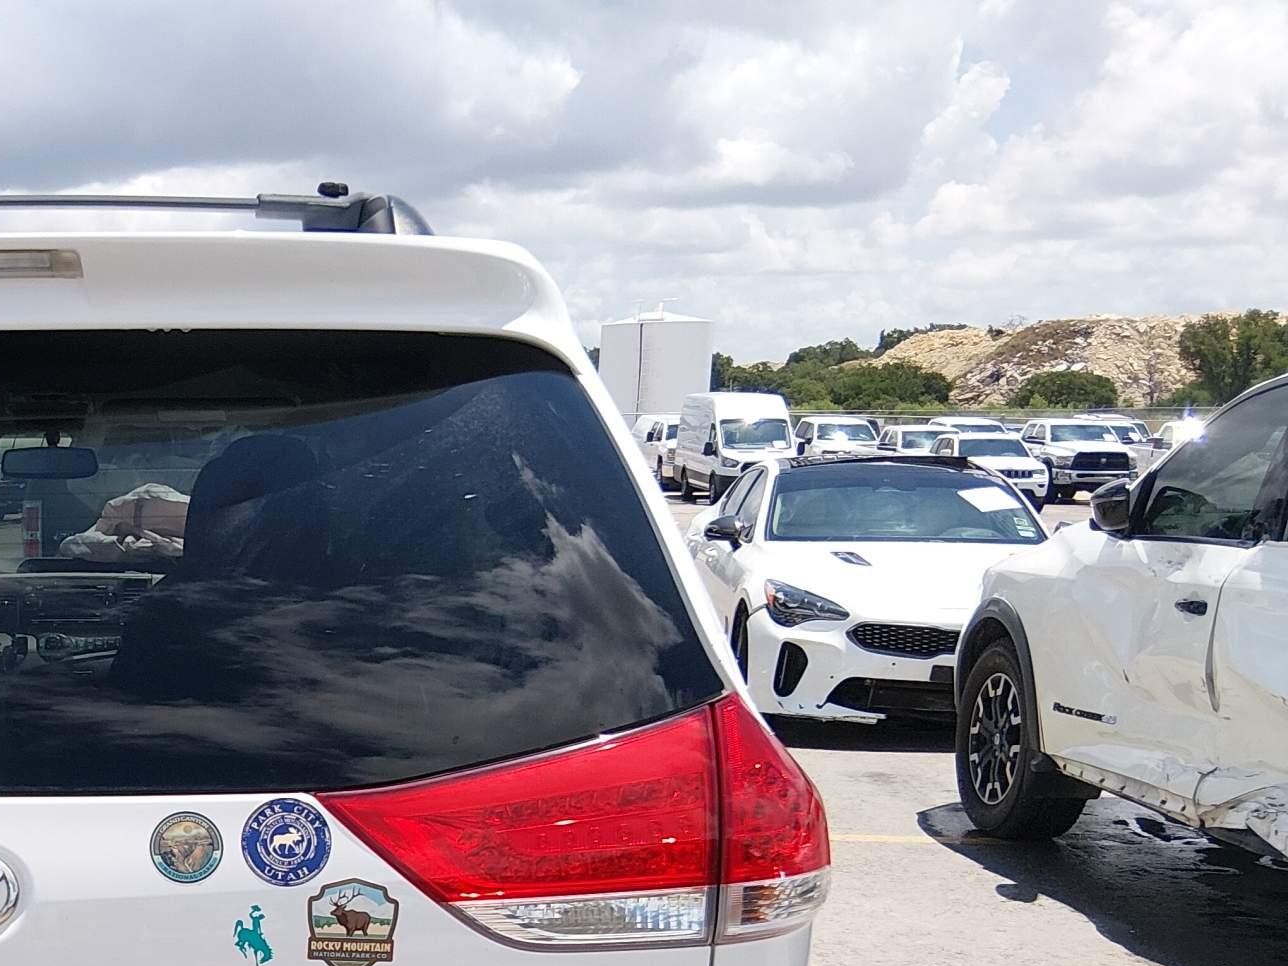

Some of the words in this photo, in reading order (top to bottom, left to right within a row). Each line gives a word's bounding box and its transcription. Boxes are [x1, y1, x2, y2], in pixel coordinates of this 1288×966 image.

[251, 804, 283, 830] PARK
[293, 805, 323, 829] CITY
[264, 865, 310, 881] UTAH
[311, 941, 342, 951] ROCKY
[343, 941, 392, 952] MOUNTAIN
